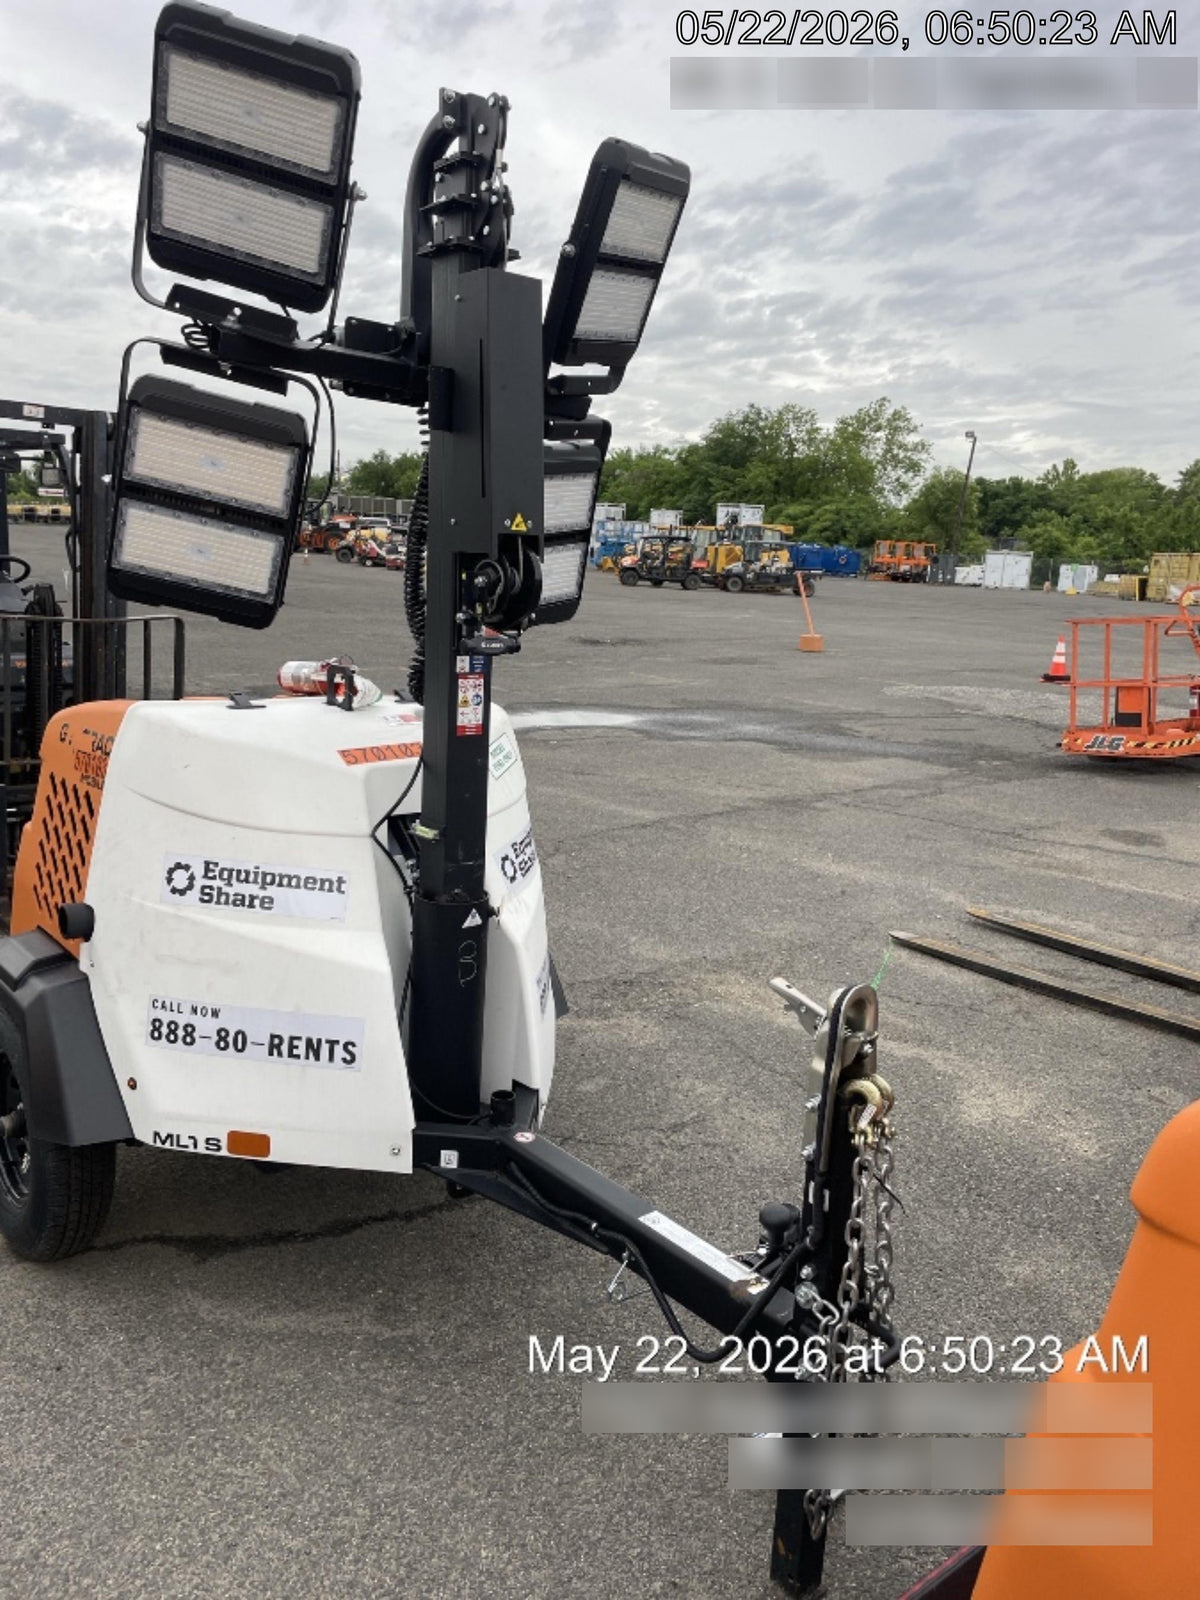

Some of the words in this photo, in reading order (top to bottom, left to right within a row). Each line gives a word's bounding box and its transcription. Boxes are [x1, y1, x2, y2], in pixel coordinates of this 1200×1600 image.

[1084, 734, 1126, 751] JLG
[202, 860, 347, 894] Equipment
[199, 885, 274, 910] Share
[152, 999, 184, 1014] CALL
[191, 1004, 221, 1019] NOW
[150, 1018, 358, 1066] 888-80-RENTS
